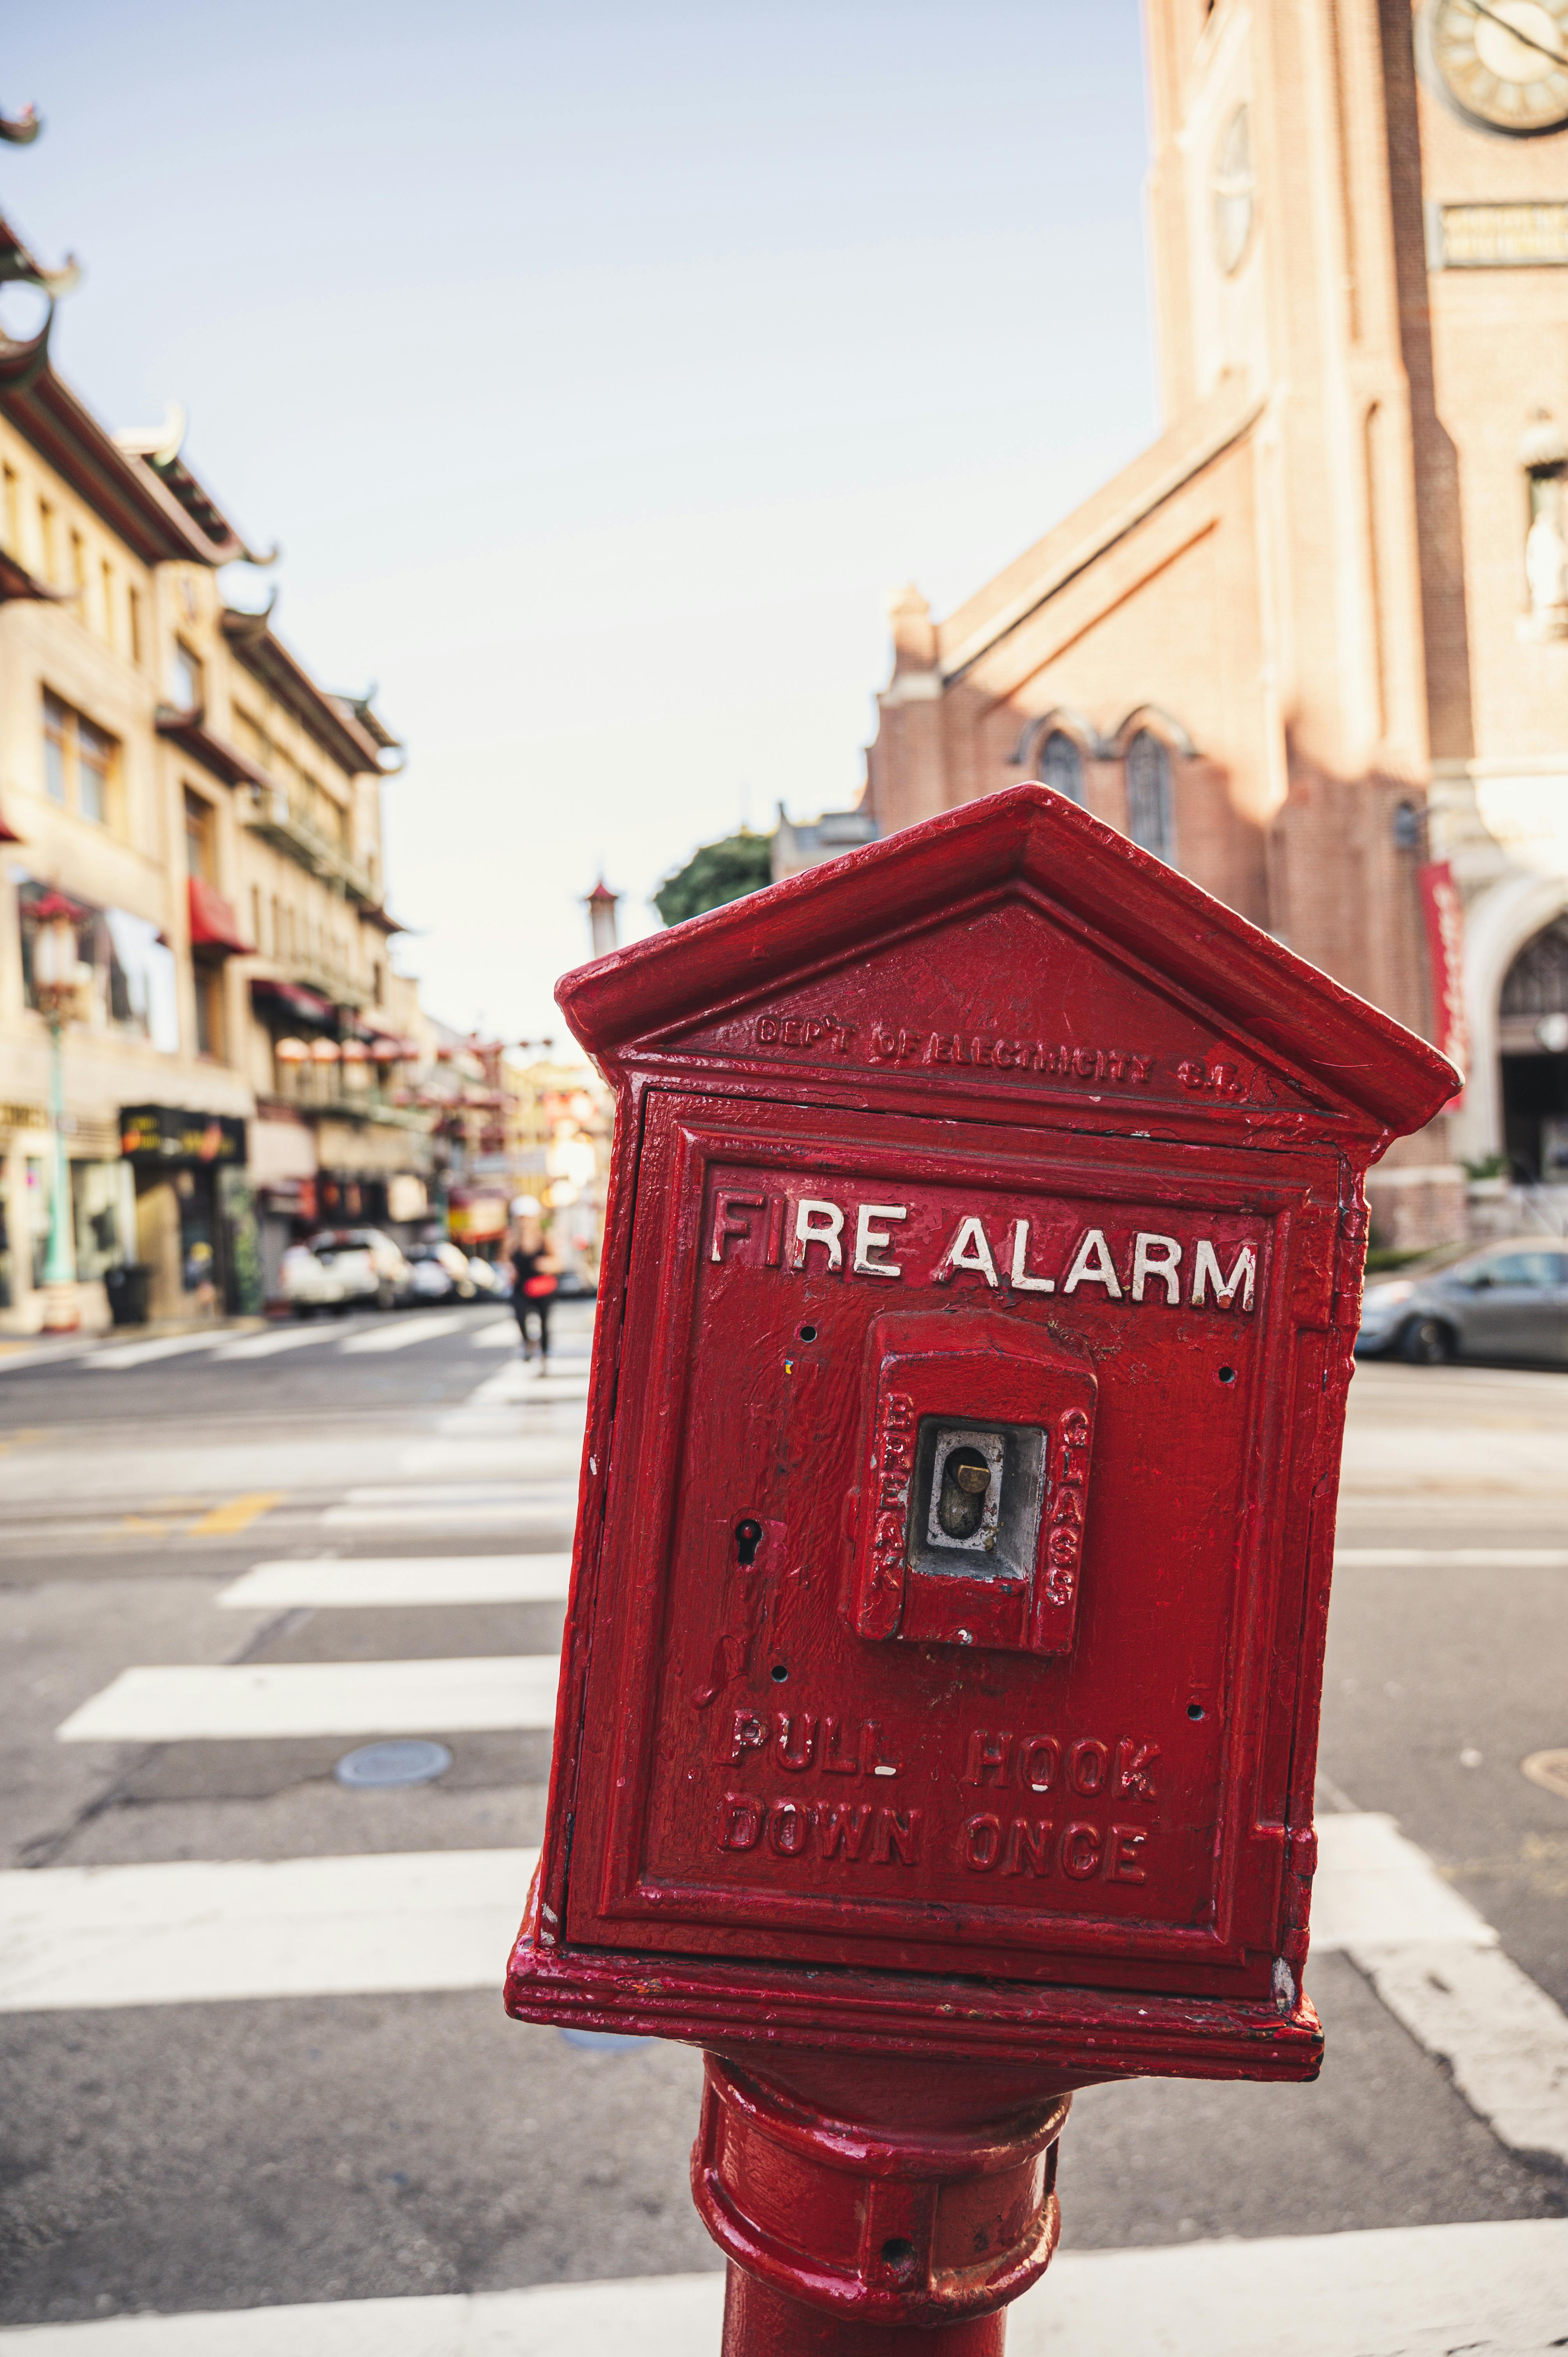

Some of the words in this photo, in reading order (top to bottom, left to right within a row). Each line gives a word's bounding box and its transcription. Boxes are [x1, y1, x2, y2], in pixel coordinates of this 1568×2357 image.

[759, 1014, 857, 1053] DEP'T
[870, 1023, 922, 1060] OF
[926, 1031, 1156, 1083] ELECTRICITY
[711, 1187, 908, 1277] FIRE
[931, 1215, 1259, 1313] ALARM
[871, 1392, 914, 1590] BREAK
[1046, 1407, 1089, 1607] GLASS
[715, 1709, 902, 1776] PULL
[962, 1729, 1162, 1805] HOOK
[715, 1792, 923, 1866] DOWN
[961, 1812, 1149, 1885] ONCE
